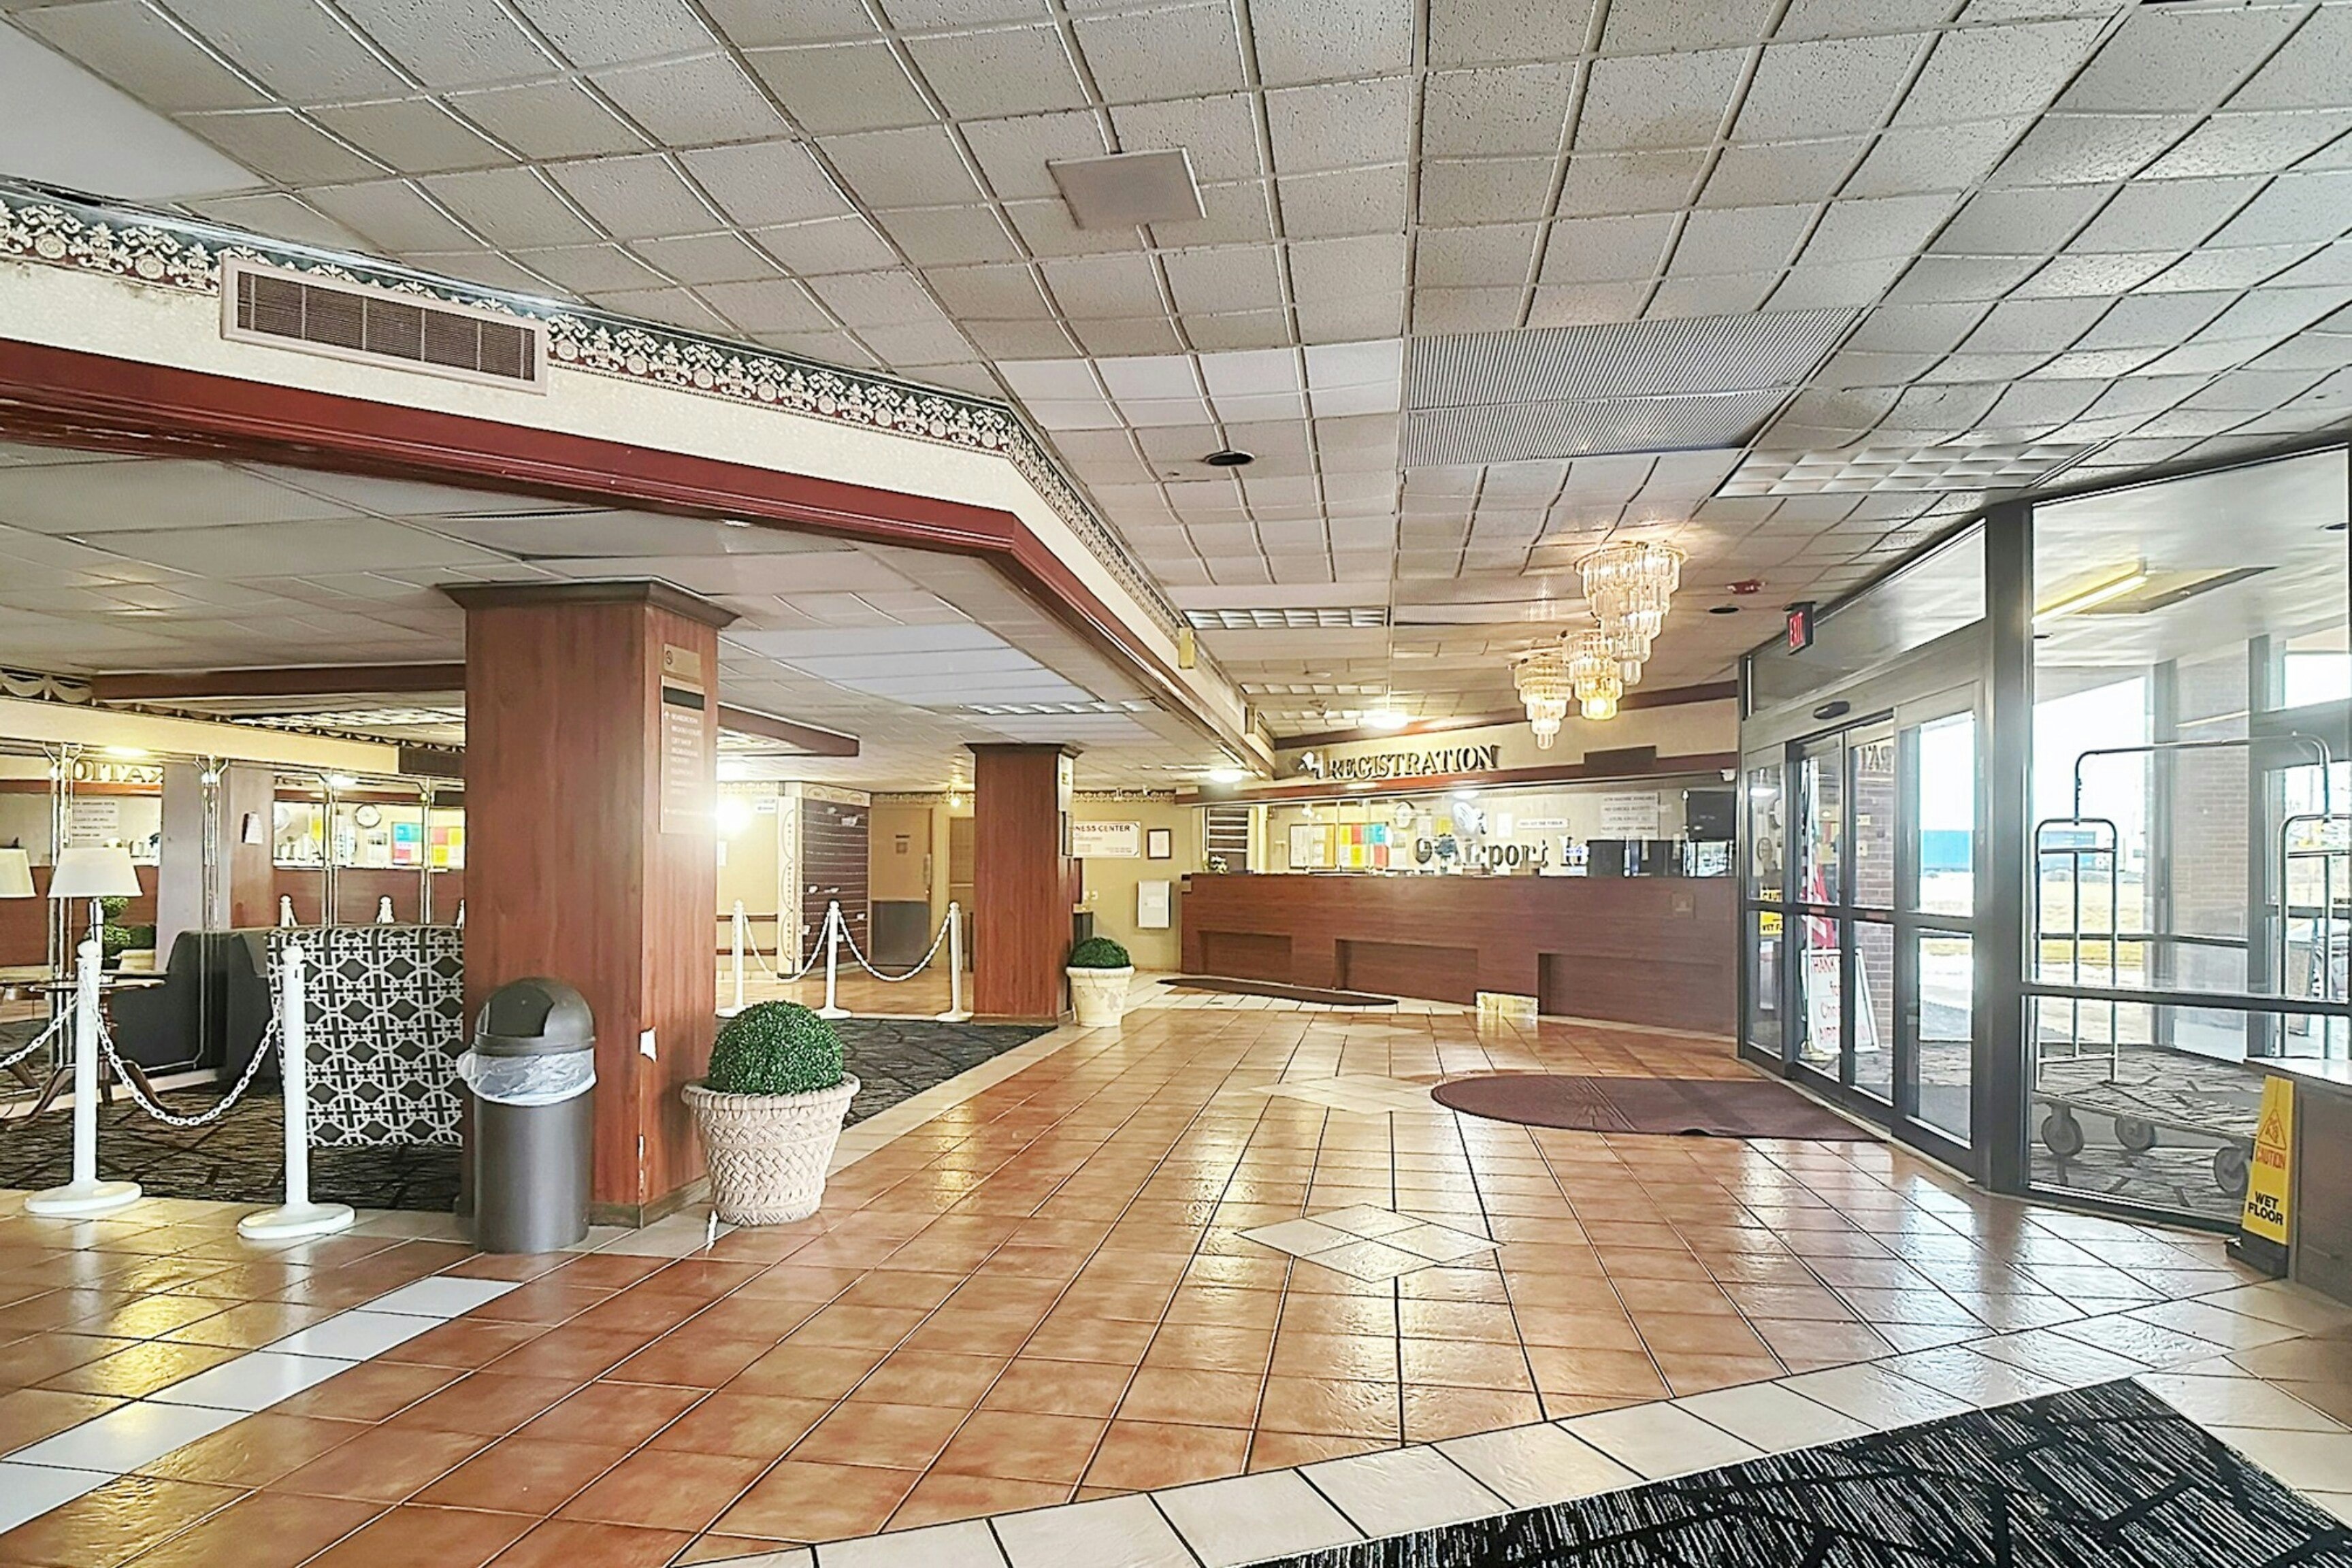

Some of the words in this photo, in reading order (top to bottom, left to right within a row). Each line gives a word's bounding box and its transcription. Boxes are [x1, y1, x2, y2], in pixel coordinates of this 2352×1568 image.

[1789, 612, 1803, 647] EXIT
[1327, 745, 1501, 780] REGISTRATION
[1098, 824, 1130, 832] CENTER
[2255, 1145, 2286, 1171] CAUTION
[2255, 1191, 2279, 1210] WET
[2248, 1202, 2283, 1226] FLOOR
